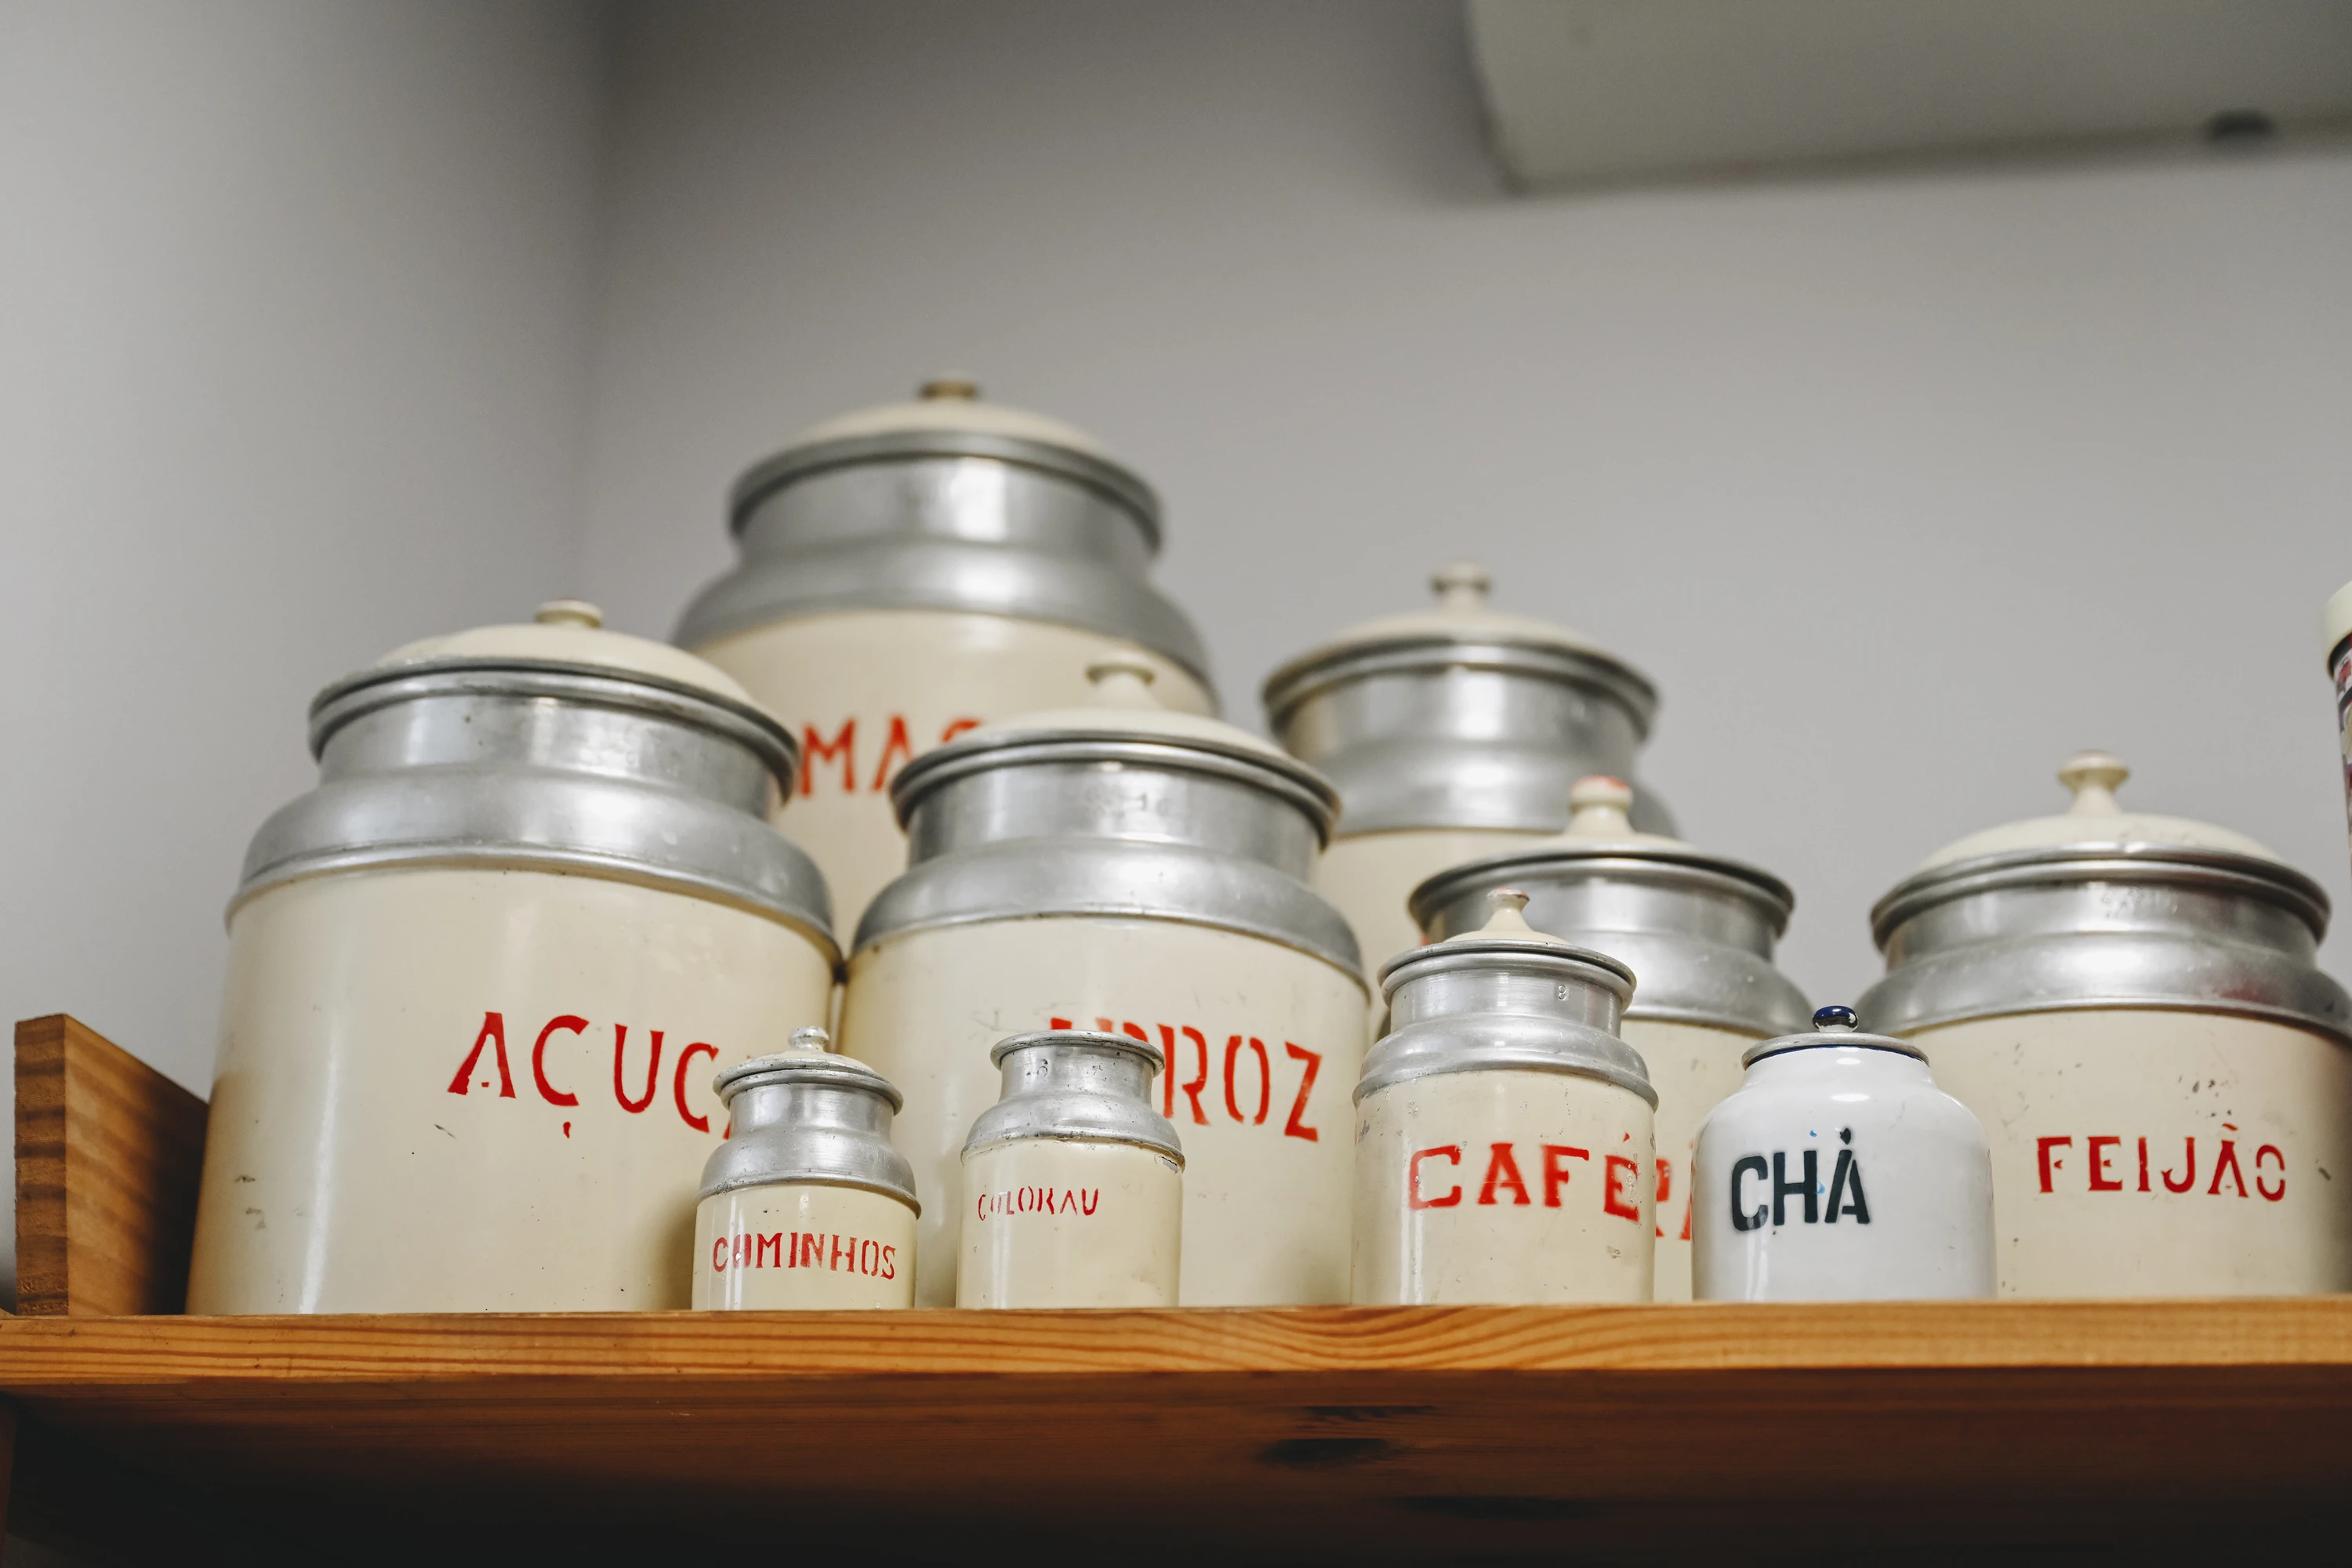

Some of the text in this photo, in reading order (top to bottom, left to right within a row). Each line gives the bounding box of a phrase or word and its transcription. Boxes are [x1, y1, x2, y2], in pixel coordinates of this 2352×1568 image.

[448, 1011, 732, 1142] AÇUC
[1049, 1016, 1323, 1143] ROZ
[1409, 1132, 1641, 1224] CAFÉ
[2036, 1122, 2287, 1203] FEIJÃO
